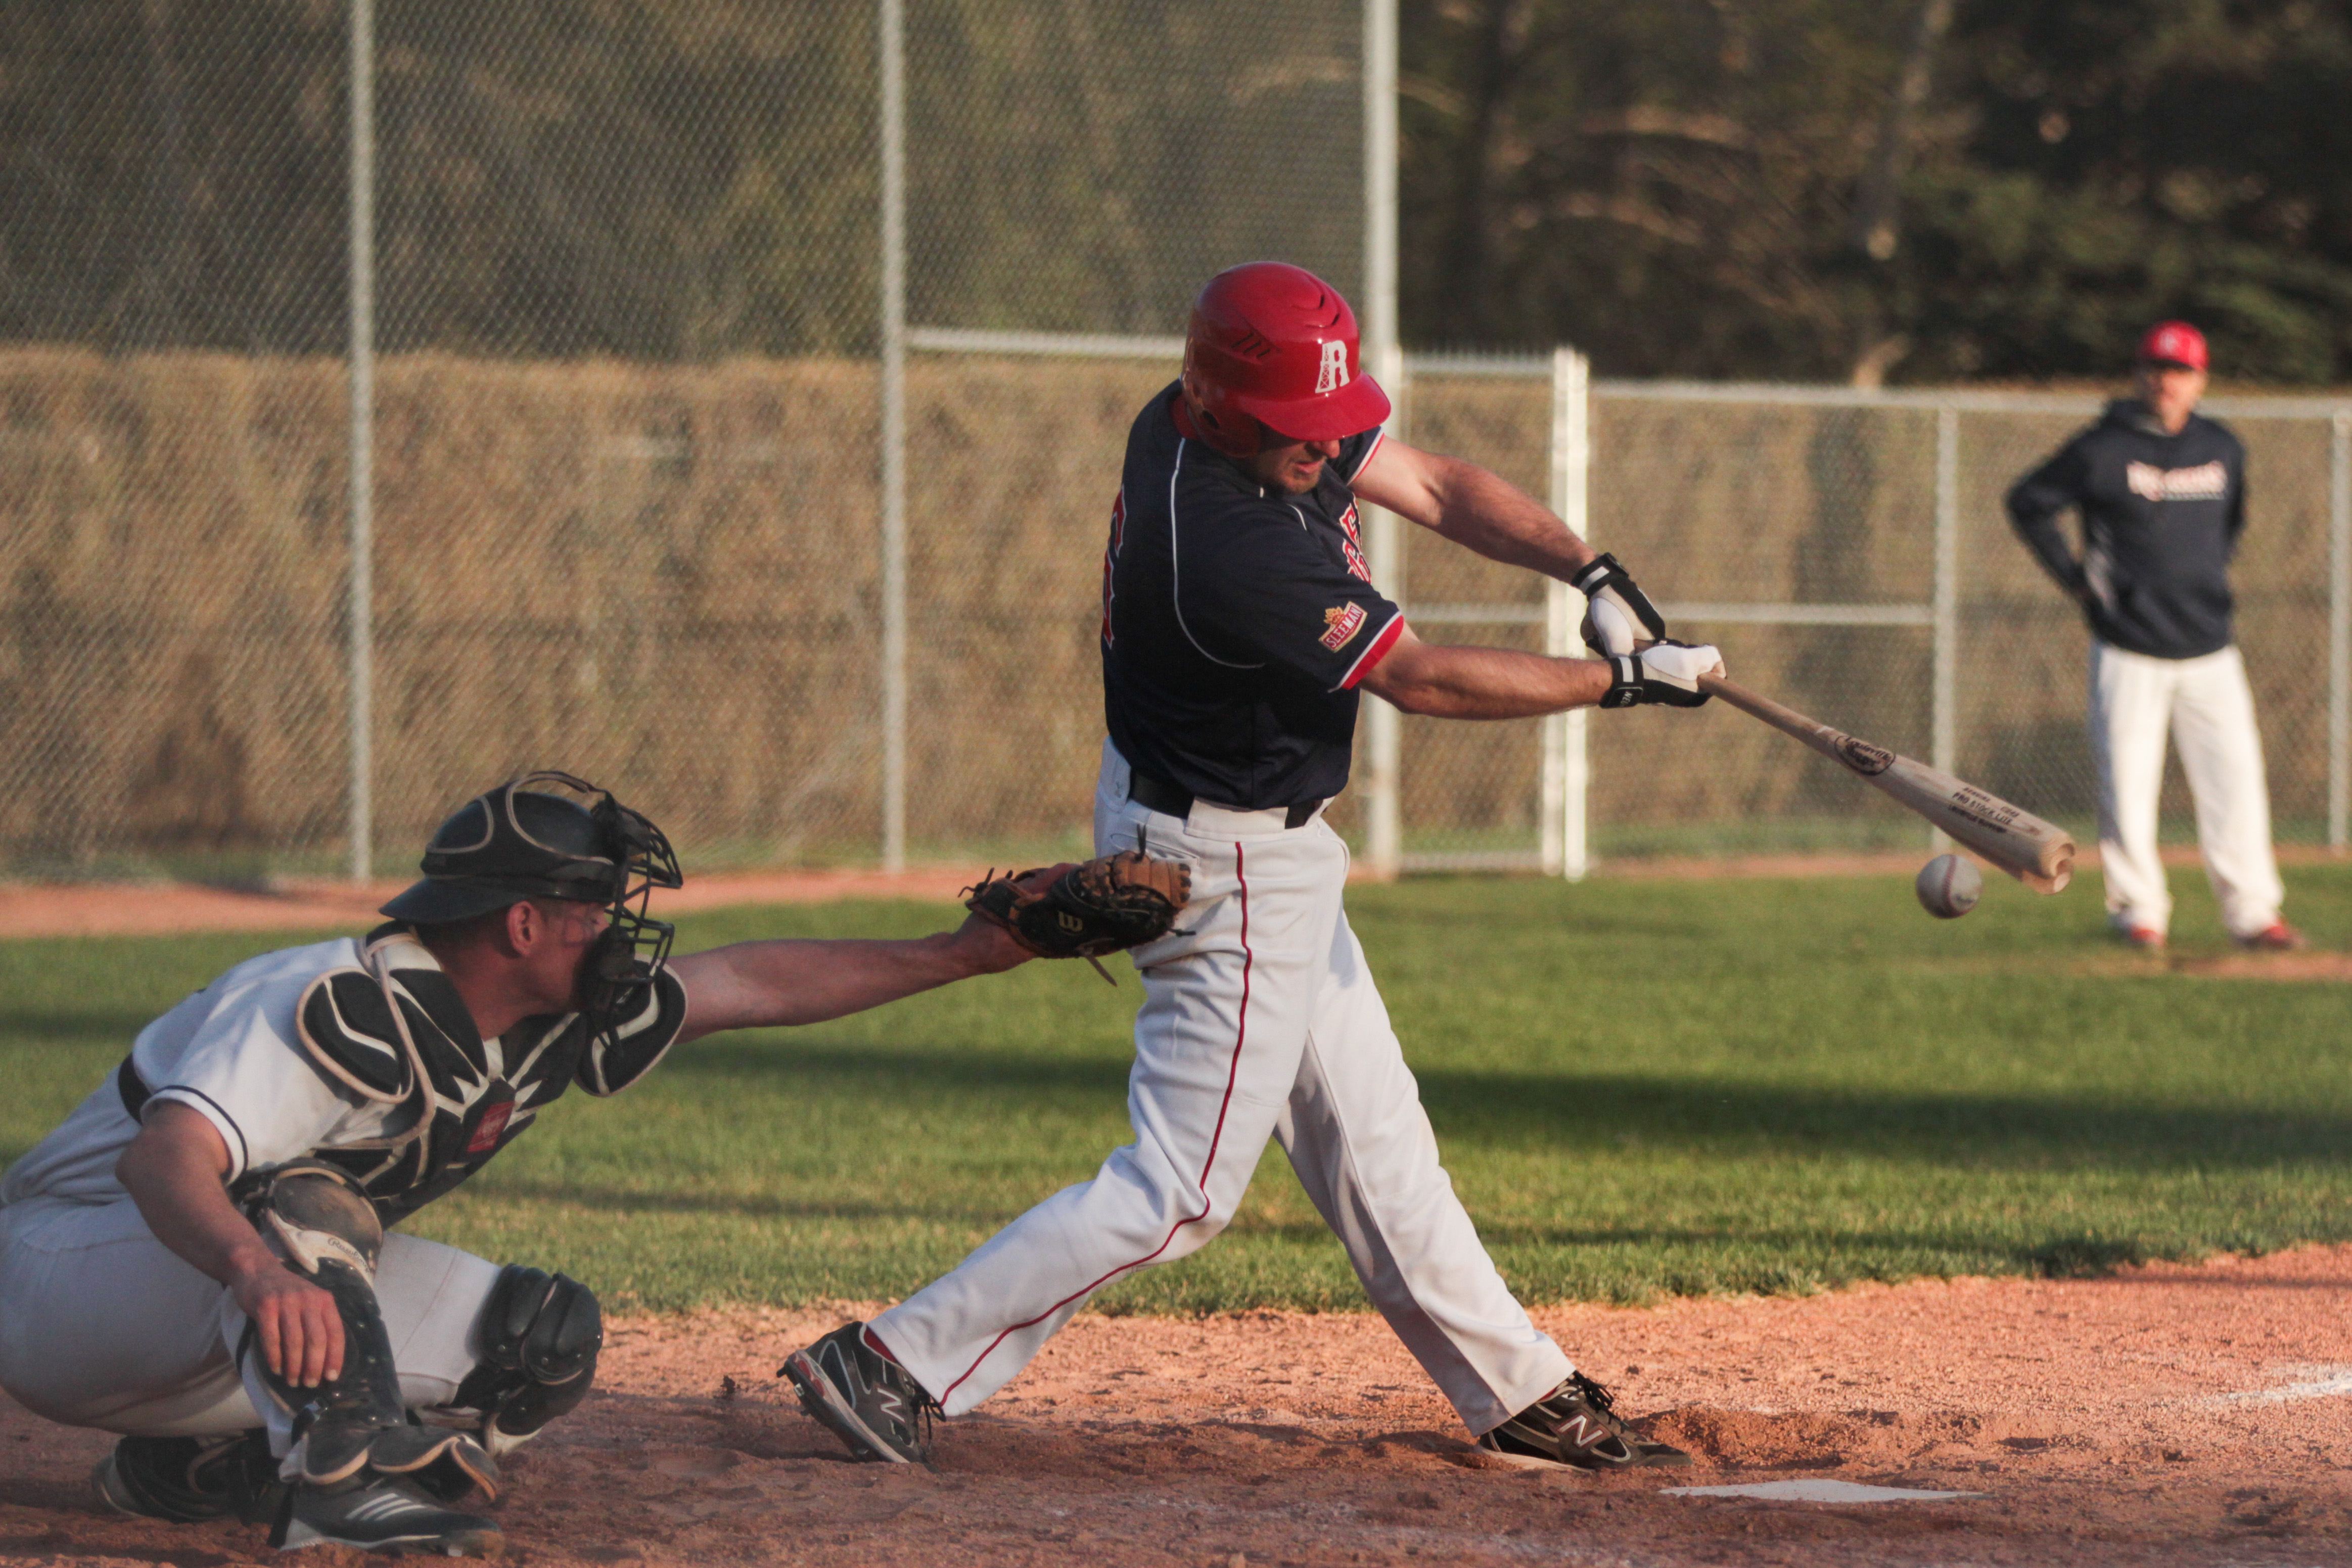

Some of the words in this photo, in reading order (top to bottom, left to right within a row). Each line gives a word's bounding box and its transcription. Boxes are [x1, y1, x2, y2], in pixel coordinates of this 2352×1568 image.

[1315, 340, 1351, 394] R
[1326, 607, 1362, 648] SLEEMAN
[1557, 1415, 1603, 1447] N
